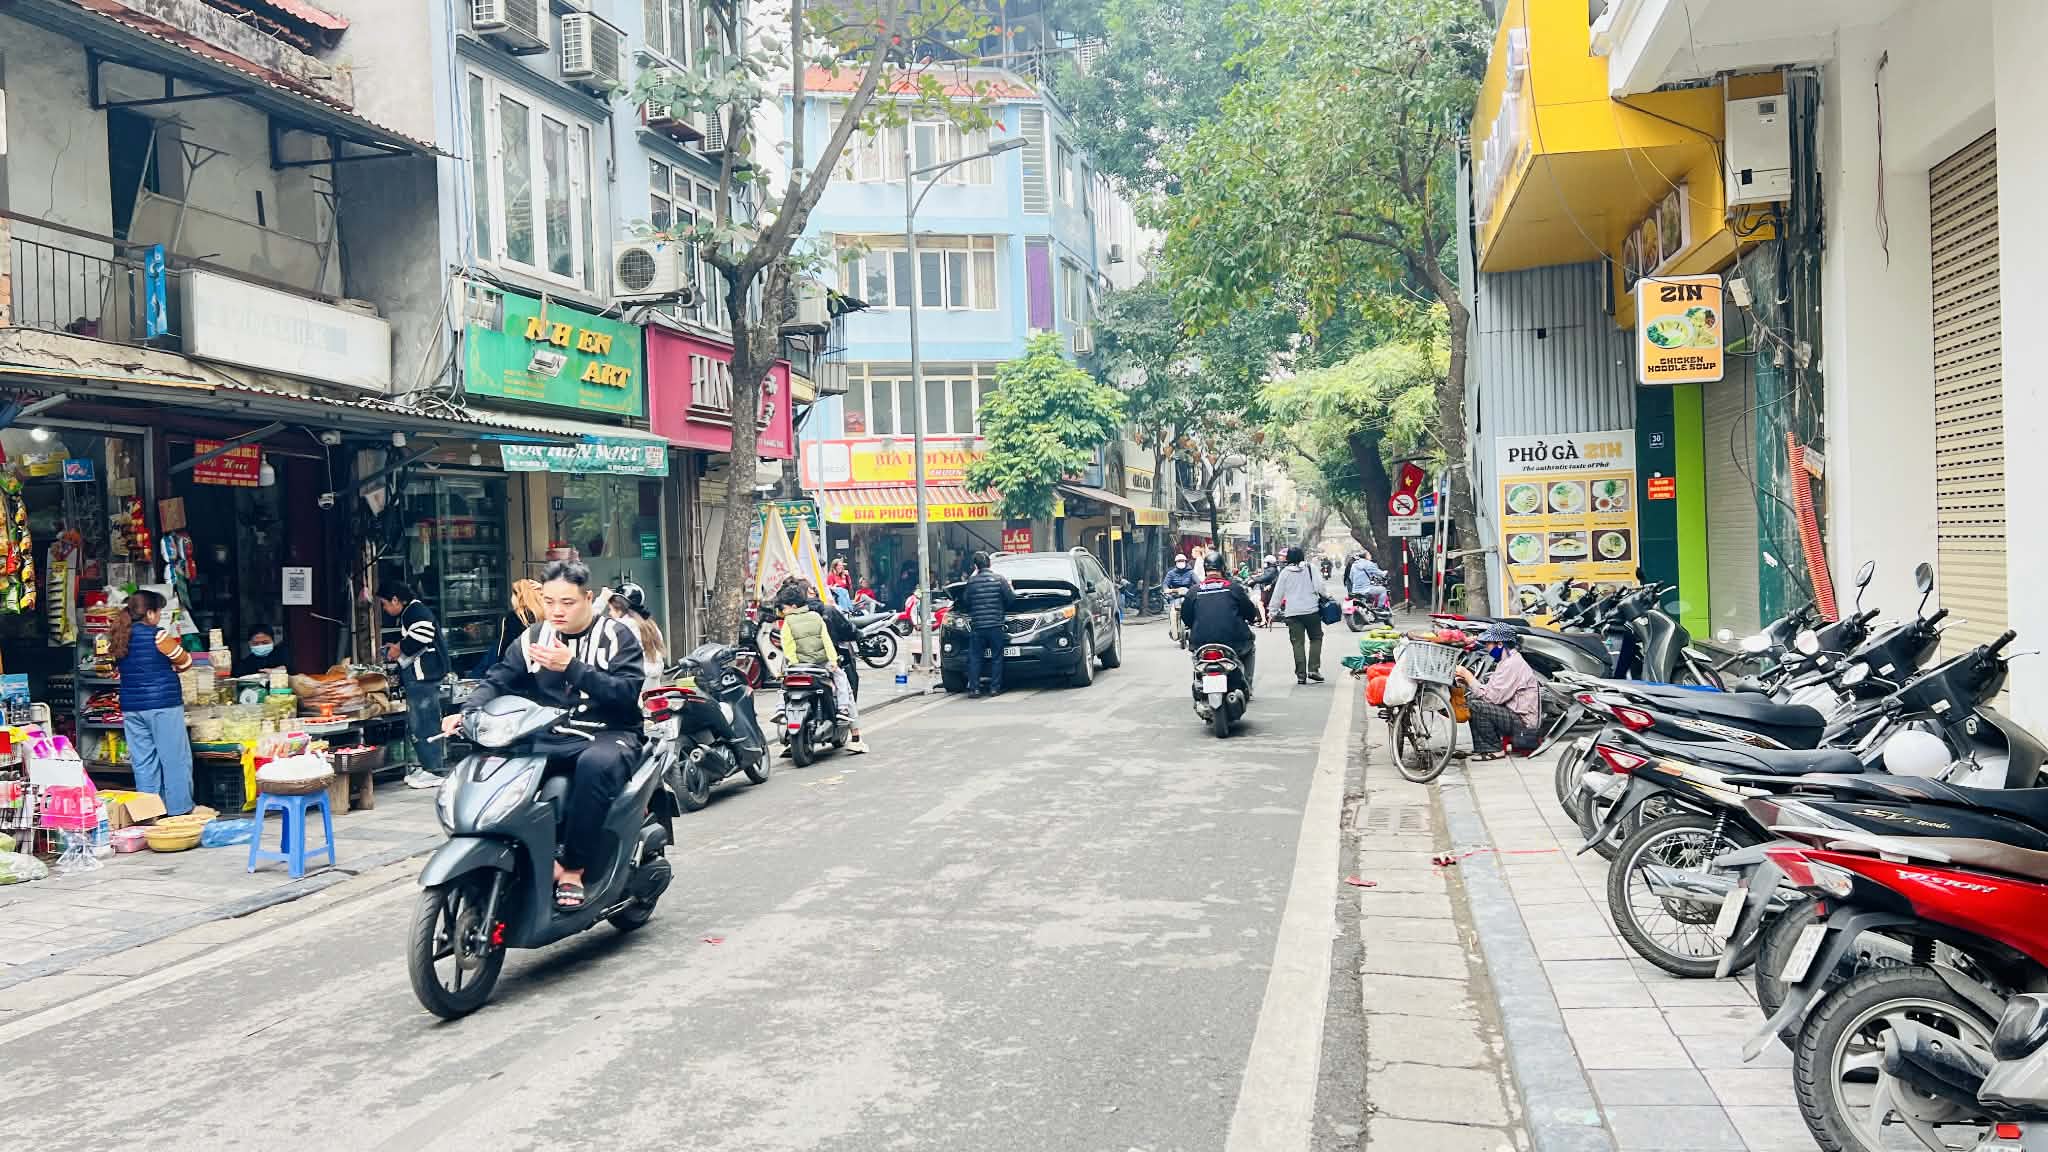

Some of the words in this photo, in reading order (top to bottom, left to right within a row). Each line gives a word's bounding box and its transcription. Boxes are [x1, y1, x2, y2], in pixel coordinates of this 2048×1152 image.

[1660, 284, 1703, 303] ZIN
[1648, 364, 1687, 373] NOODLE
[1689, 362, 1716, 371] SOUP
[1660, 356, 1704, 365] CHICKEN
[581, 361, 632, 389] ART
[1508, 440, 1548, 463] PHỞ
[1552, 440, 1580, 460] GÀ
[854, 508, 875, 520] BIA
[944, 506, 964, 518] BIA
